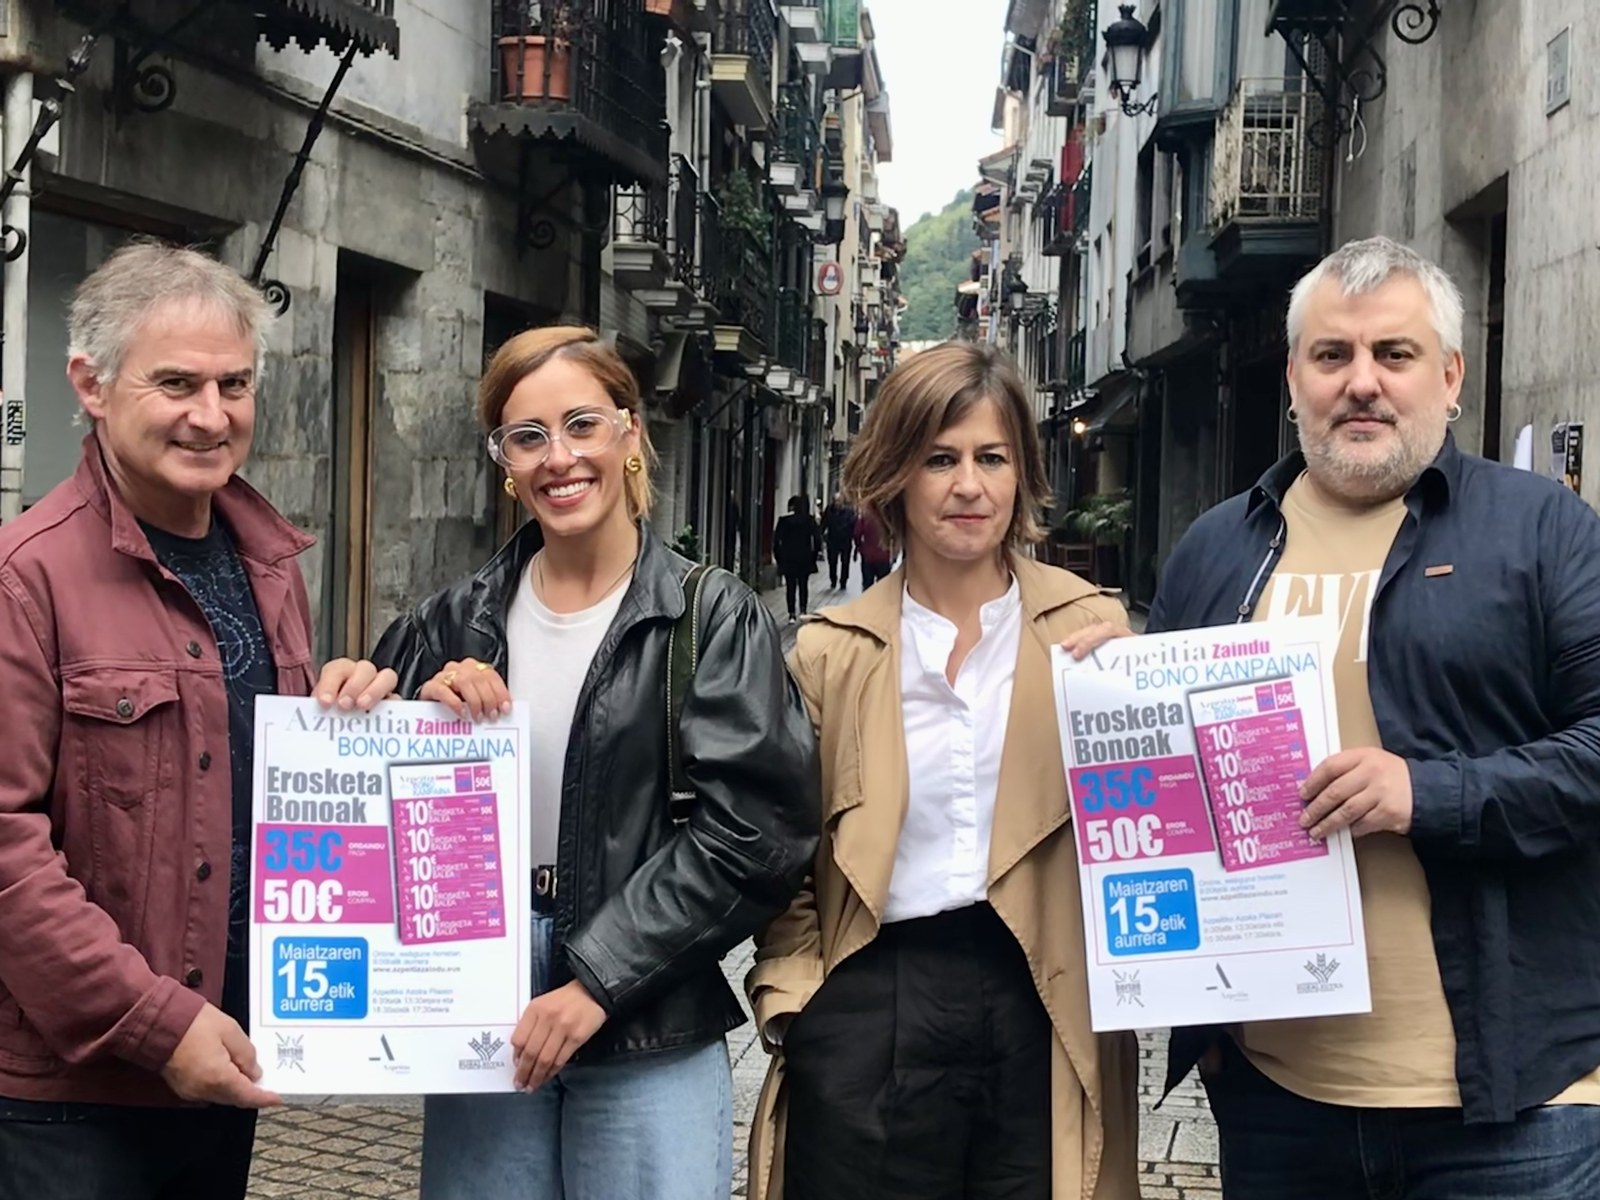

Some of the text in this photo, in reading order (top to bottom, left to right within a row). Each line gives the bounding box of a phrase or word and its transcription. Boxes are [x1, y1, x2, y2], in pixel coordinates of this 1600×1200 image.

[1088, 639, 1270, 677] Azpeitia Zaindu
[1136, 652, 1317, 690] BONO KANPAINA
[286, 706, 473, 740] Azpeitia Zaindu
[1070, 701, 1185, 738] Erosketa
[338, 737, 515, 758] BONO KANPAINA
[1074, 729, 1173, 765] Bonoak
[266, 766, 382, 796] Erosketa
[1079, 766, 1156, 814] 35€
[266, 795, 367, 823] Bonoak
[264, 829, 343, 872] 35€
[1086, 814, 1164, 862] 50€
[263, 879, 343, 923] 50€
[1109, 877, 1188, 898] Maiatzaren
[279, 944, 361, 960] Maiatzaren
[1115, 932, 1166, 949] aurrera
[280, 999, 334, 1012] aurrera
